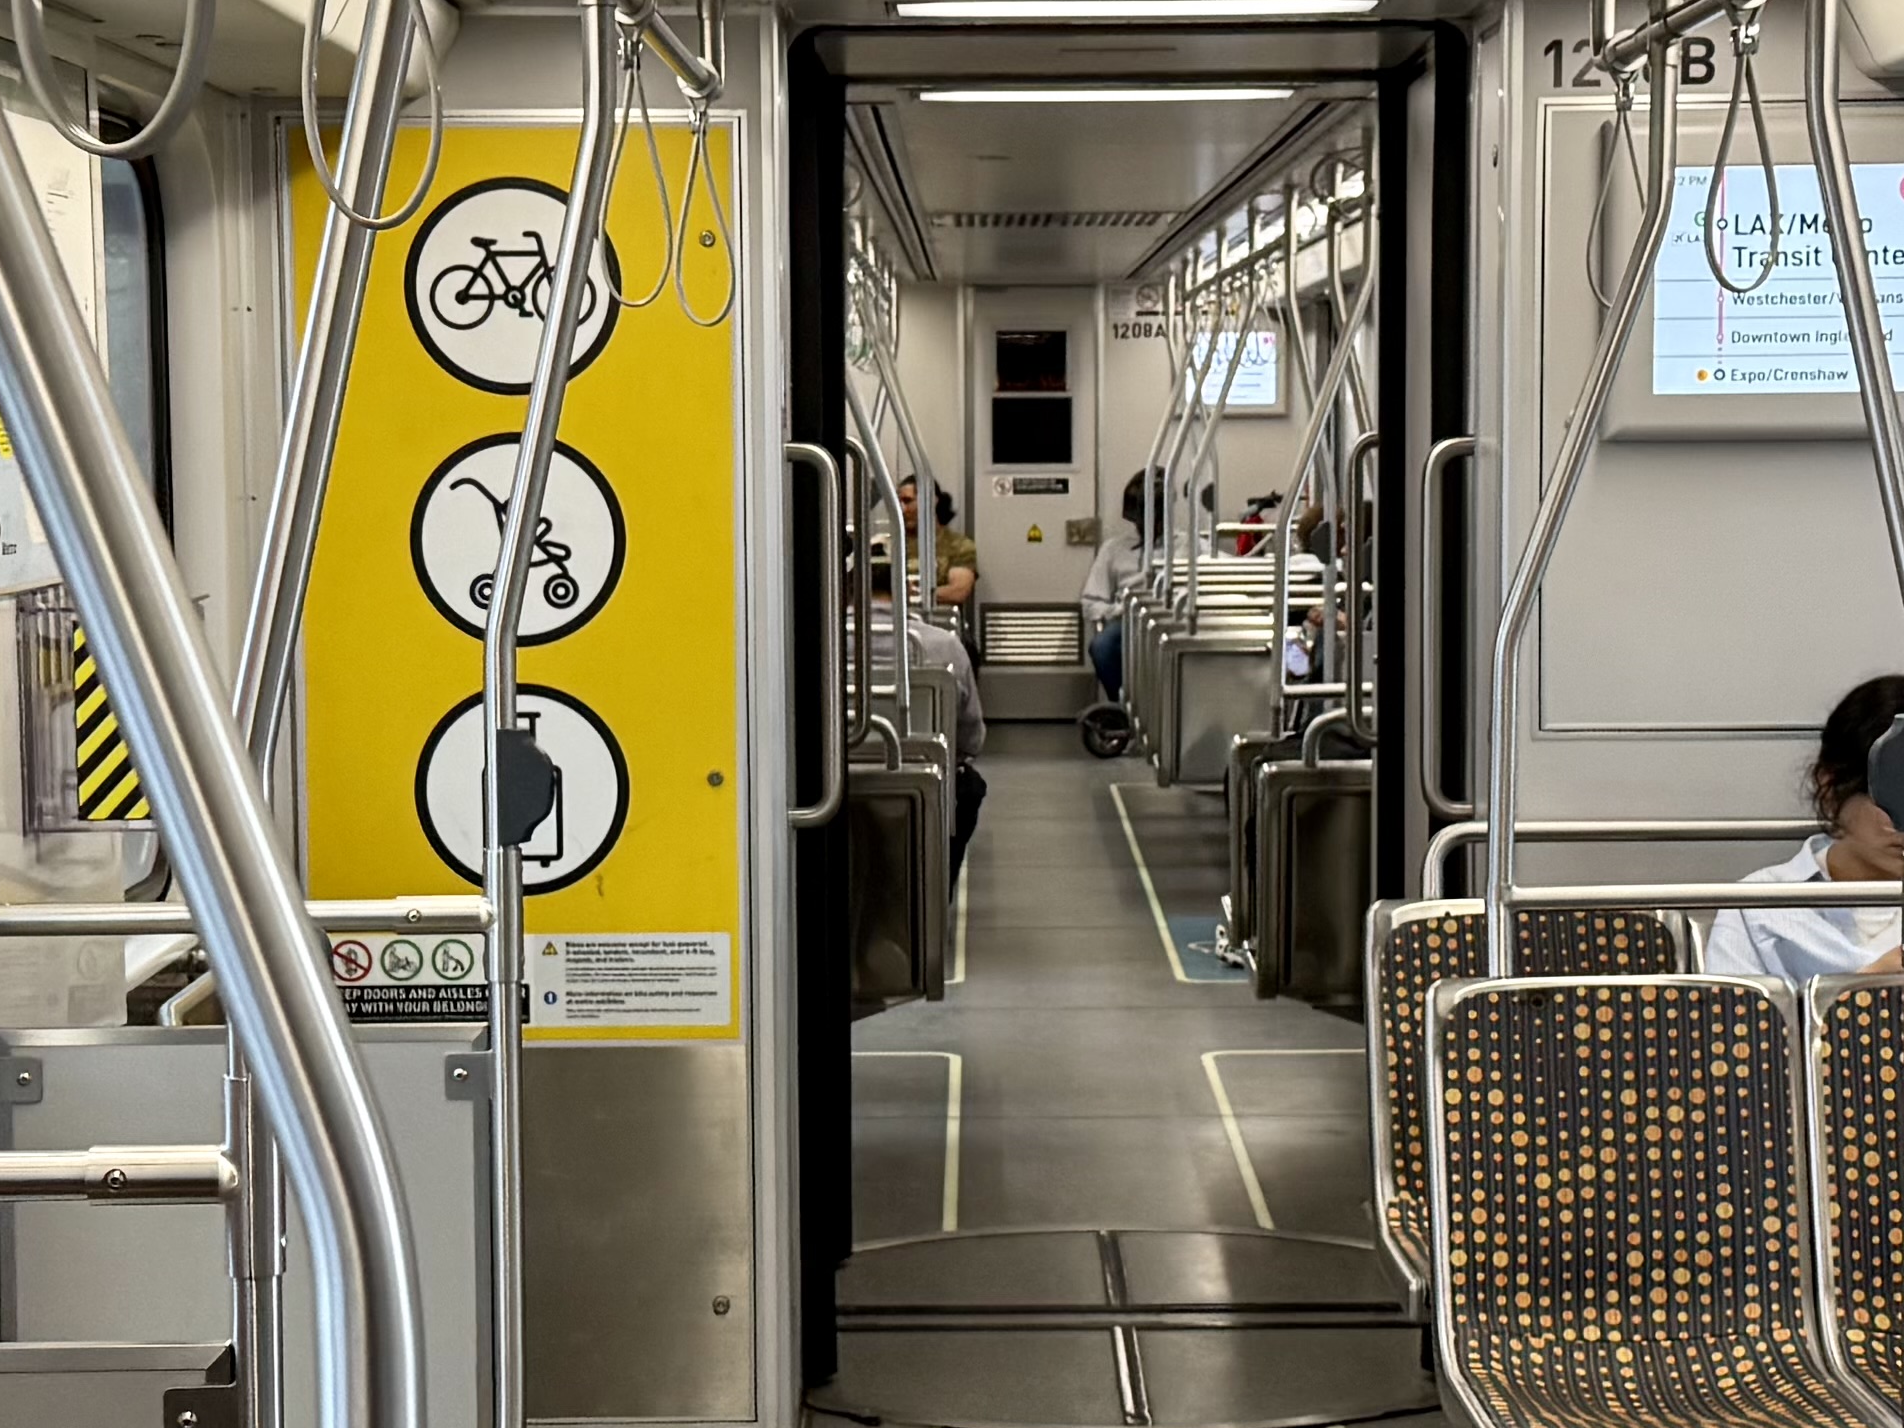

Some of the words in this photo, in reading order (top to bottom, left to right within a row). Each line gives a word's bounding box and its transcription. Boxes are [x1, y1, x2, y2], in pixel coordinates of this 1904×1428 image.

[1544, 36, 1716, 88] 12B
[1732, 245, 1823, 268] Transit
[1113, 323, 1167, 340] 1208A
[1732, 330, 1810, 344] Downtown
[1731, 368, 1848, 384] Expo/Crenshaw
[364, 987, 406, 1000] DOORS
[409, 987, 437, 1000] AND
